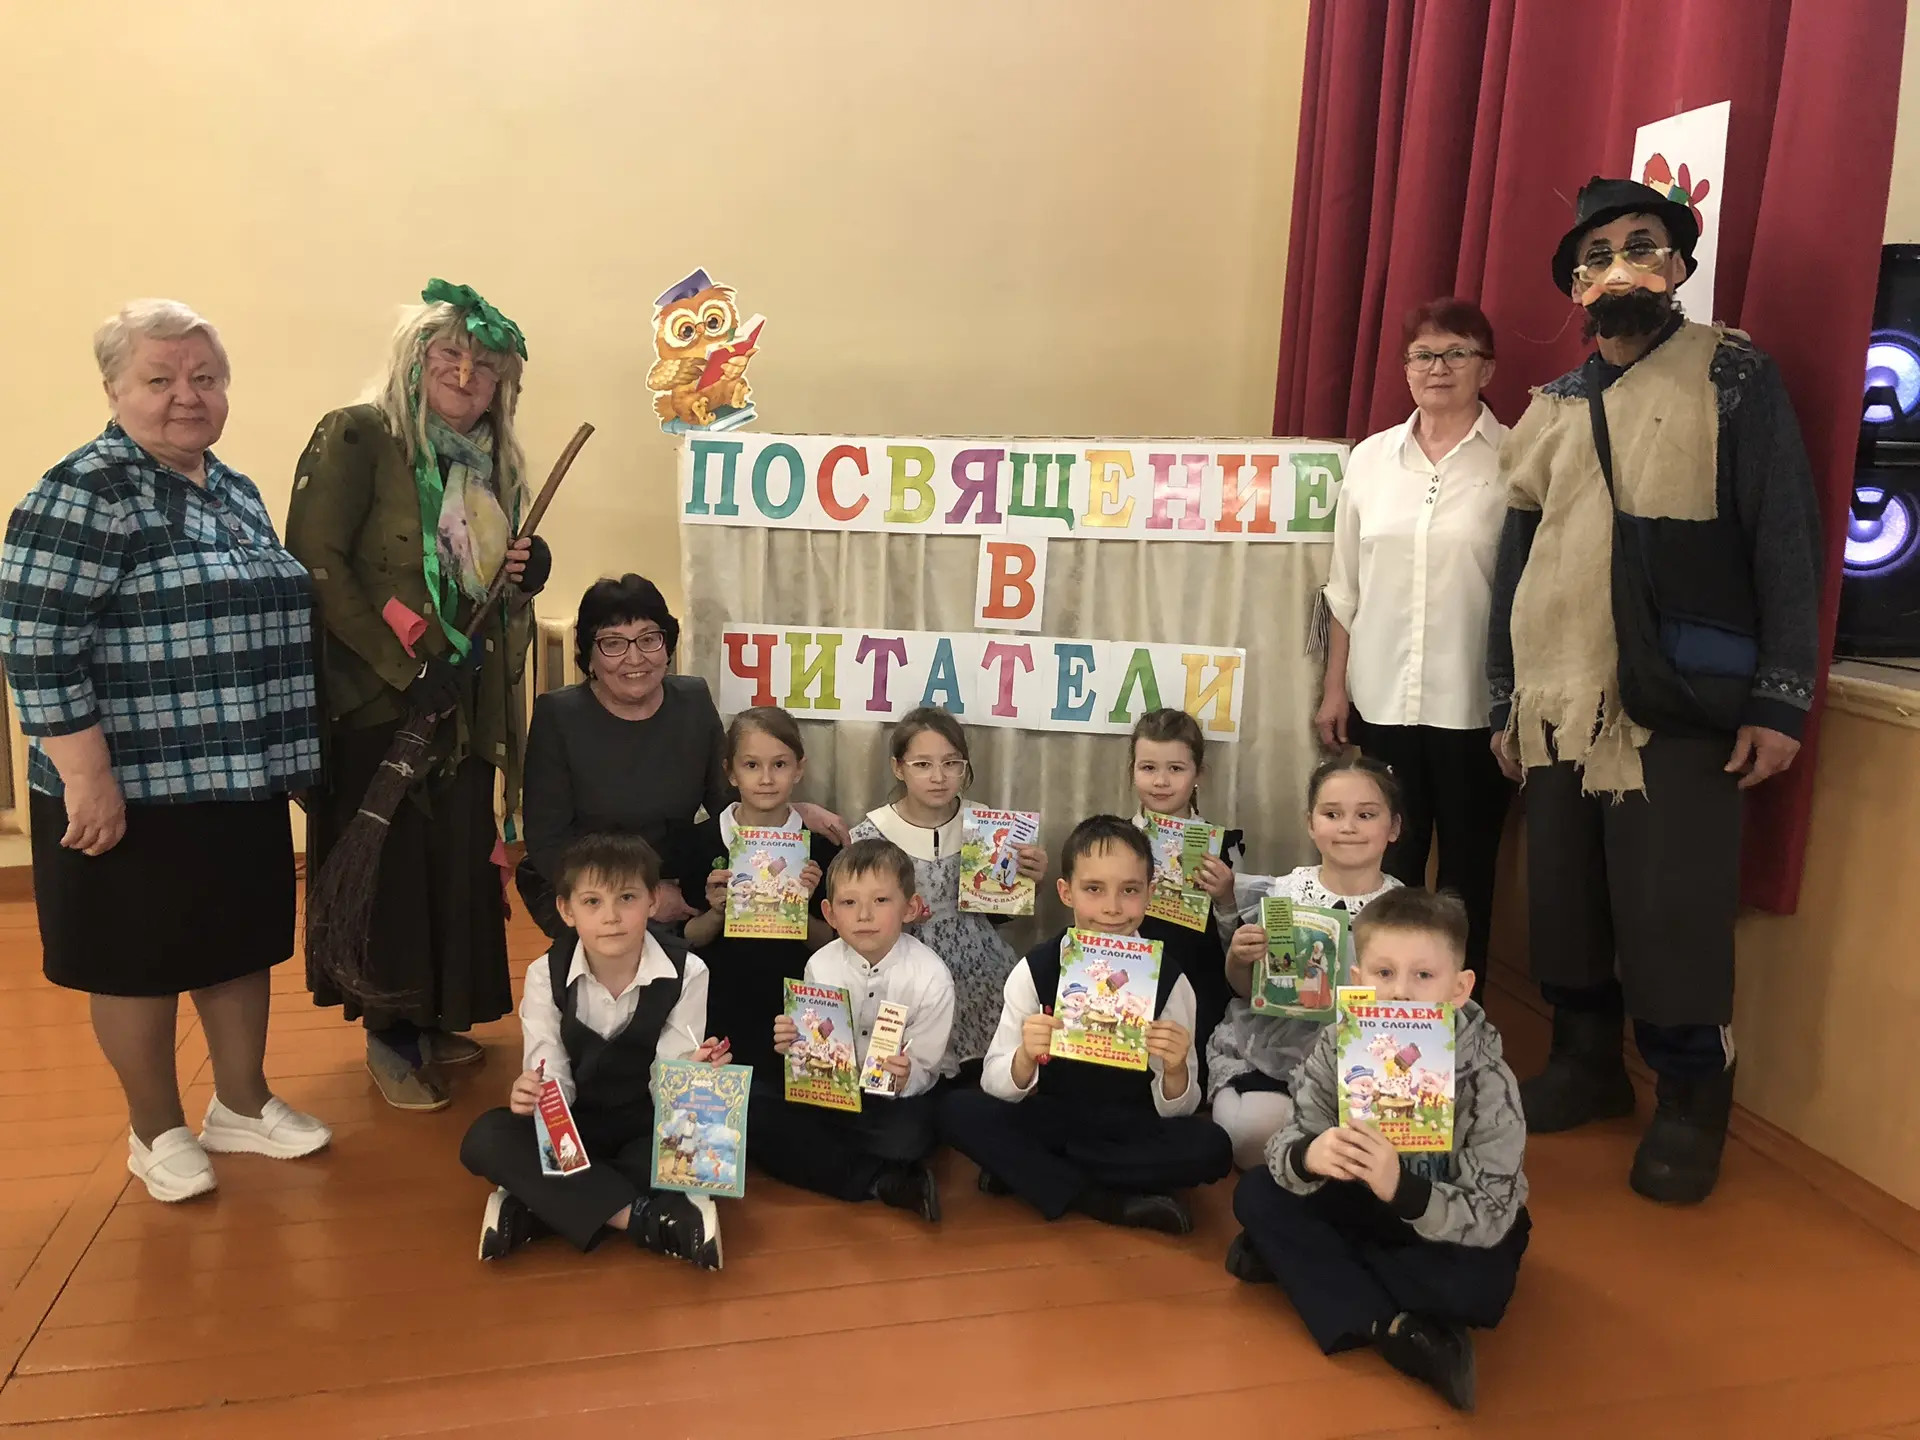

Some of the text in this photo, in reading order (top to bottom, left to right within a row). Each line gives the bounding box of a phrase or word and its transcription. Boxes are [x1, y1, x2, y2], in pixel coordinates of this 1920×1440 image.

[684, 439, 1344, 533] ПОСВЯЩЕНИЕ
[982, 542, 1036, 620] В
[723, 631, 1241, 733] ЧИТАТЕЛИ
[972, 810, 1032, 821] ЧИТА
[738, 830, 803, 841] ЧИТАЕМ
[1076, 933, 1154, 954] ЧИТАЕМ
[1100, 949, 1142, 960] СЛОГАМ
[790, 984, 844, 1002] ЧИТАЕМ
[1348, 1006, 1444, 1020] ЧИТАЕМ
[1382, 1021, 1432, 1030] СЛОГАМ
[790, 1088, 856, 1106] ПОРОСЁНКА
